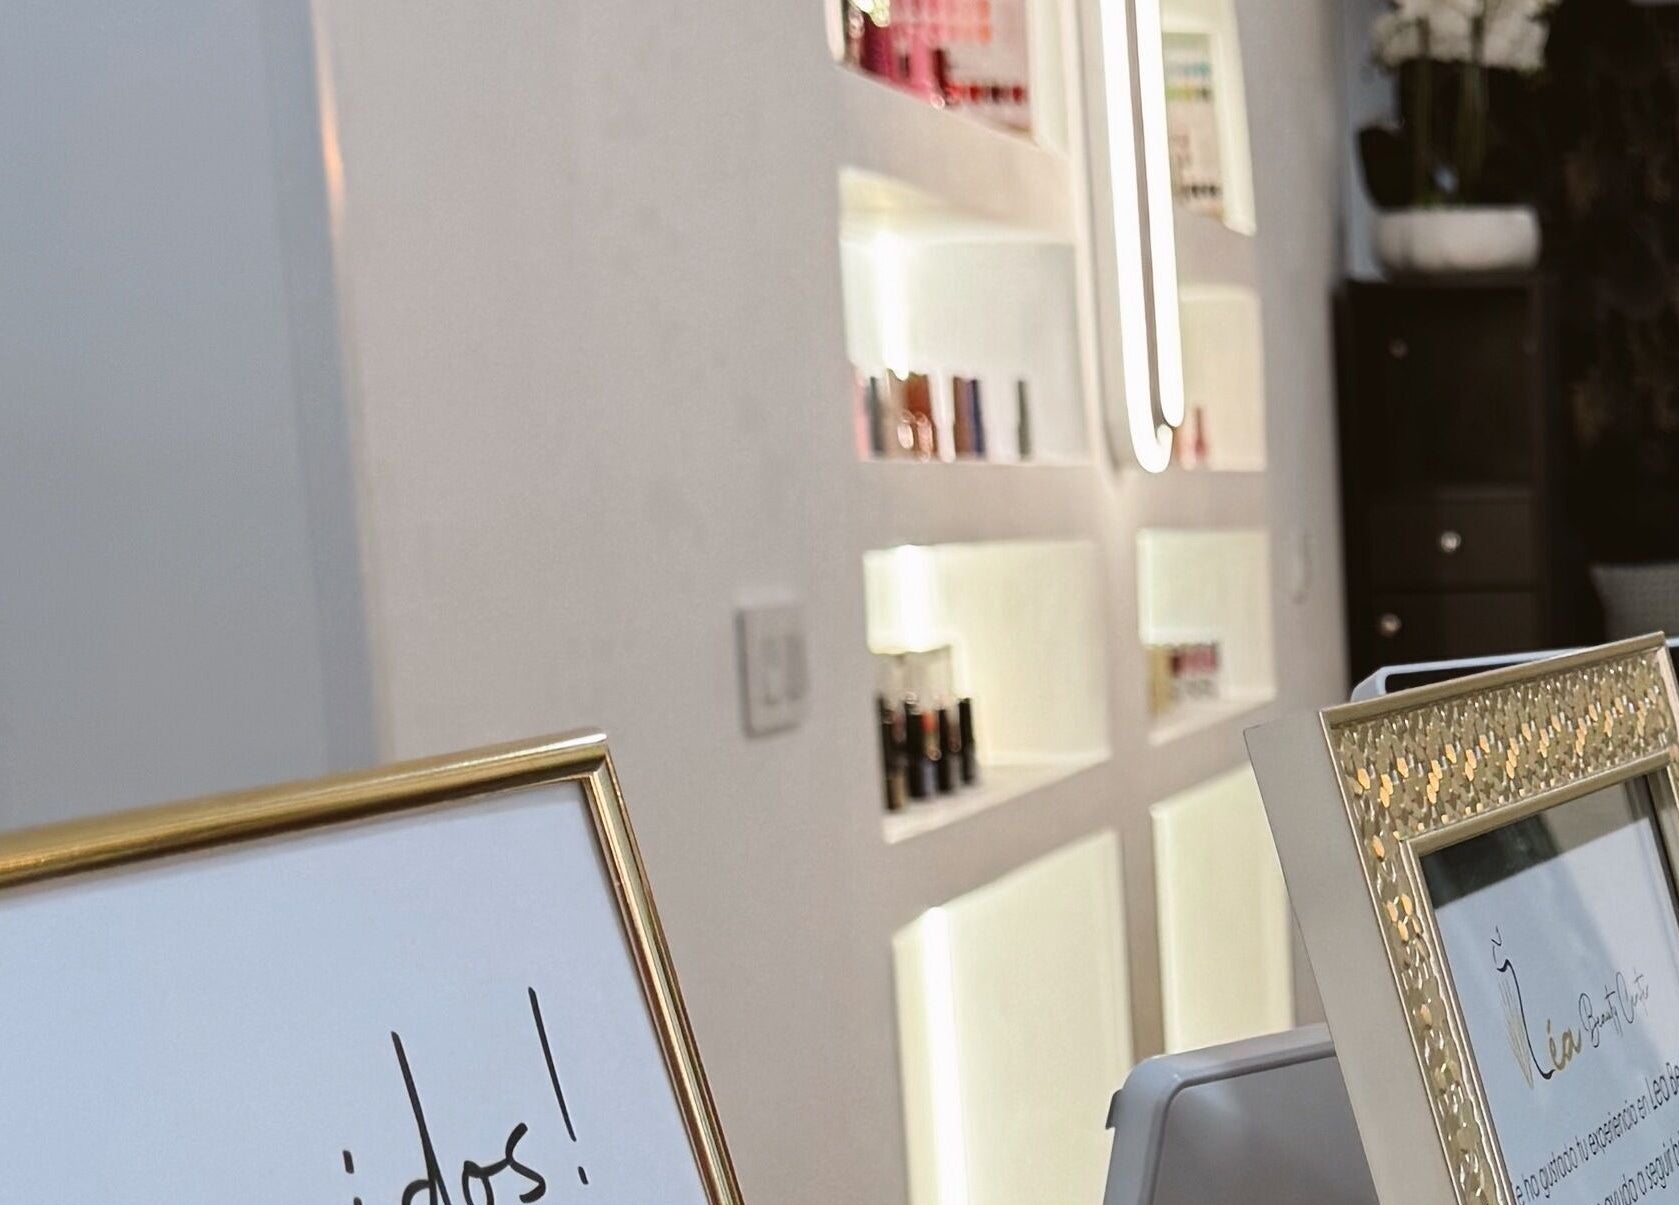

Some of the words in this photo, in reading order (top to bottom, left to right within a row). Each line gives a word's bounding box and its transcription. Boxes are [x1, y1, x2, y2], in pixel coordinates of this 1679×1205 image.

[1521, 1173, 1541, 1202] ha
[1539, 1143, 1579, 1199] gustado
[1575, 1135, 1589, 1161] tu
[1588, 1099, 1639, 1155] experiencia
[1637, 1094, 1651, 1120] en
[1637, 1170, 1648, 1196] a
[1645, 1142, 1675, 1189] seguir
